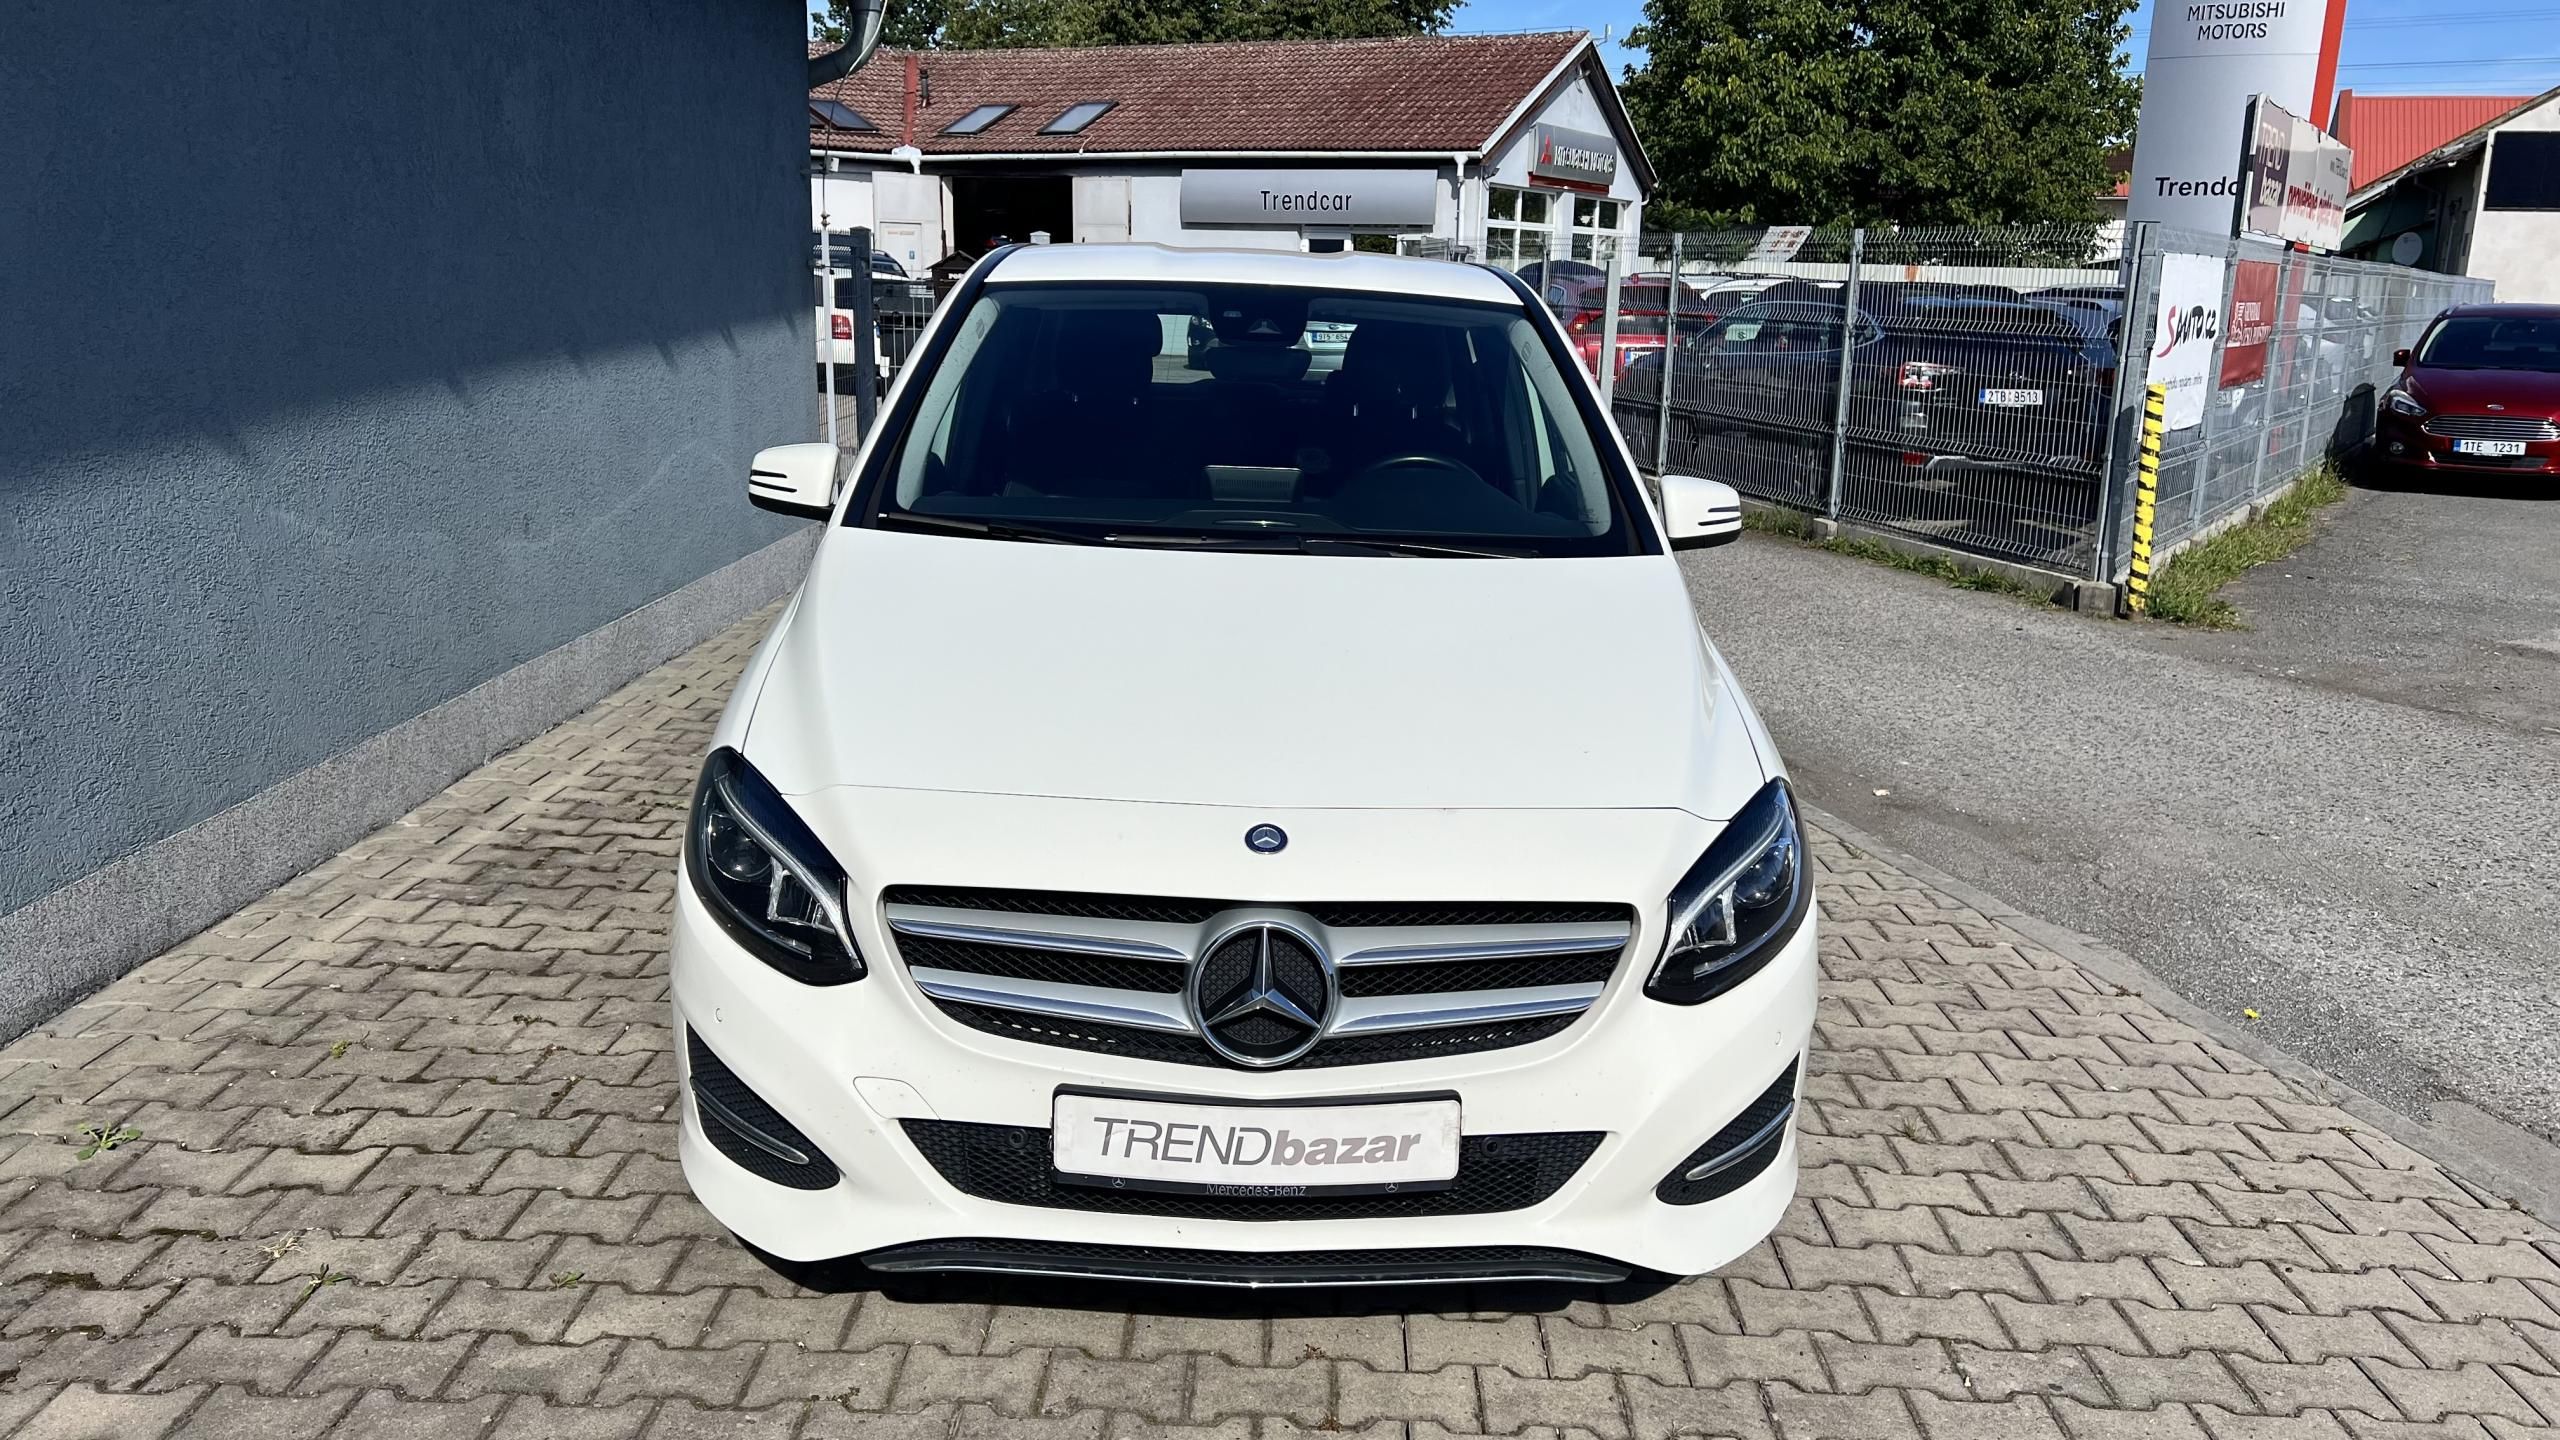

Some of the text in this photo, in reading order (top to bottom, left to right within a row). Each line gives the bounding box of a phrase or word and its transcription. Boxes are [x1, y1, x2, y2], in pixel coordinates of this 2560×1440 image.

[2187, 2, 2286, 21] MITSUBISHI
[2197, 23, 2268, 40] MOTORS
[1260, 190, 1352, 211] Trendcar
[1988, 390, 2038, 403] 2TB 9513
[2464, 441, 2520, 453] 1TE 1231
[1206, 1183, 1307, 1197] Mercedes-Benz
